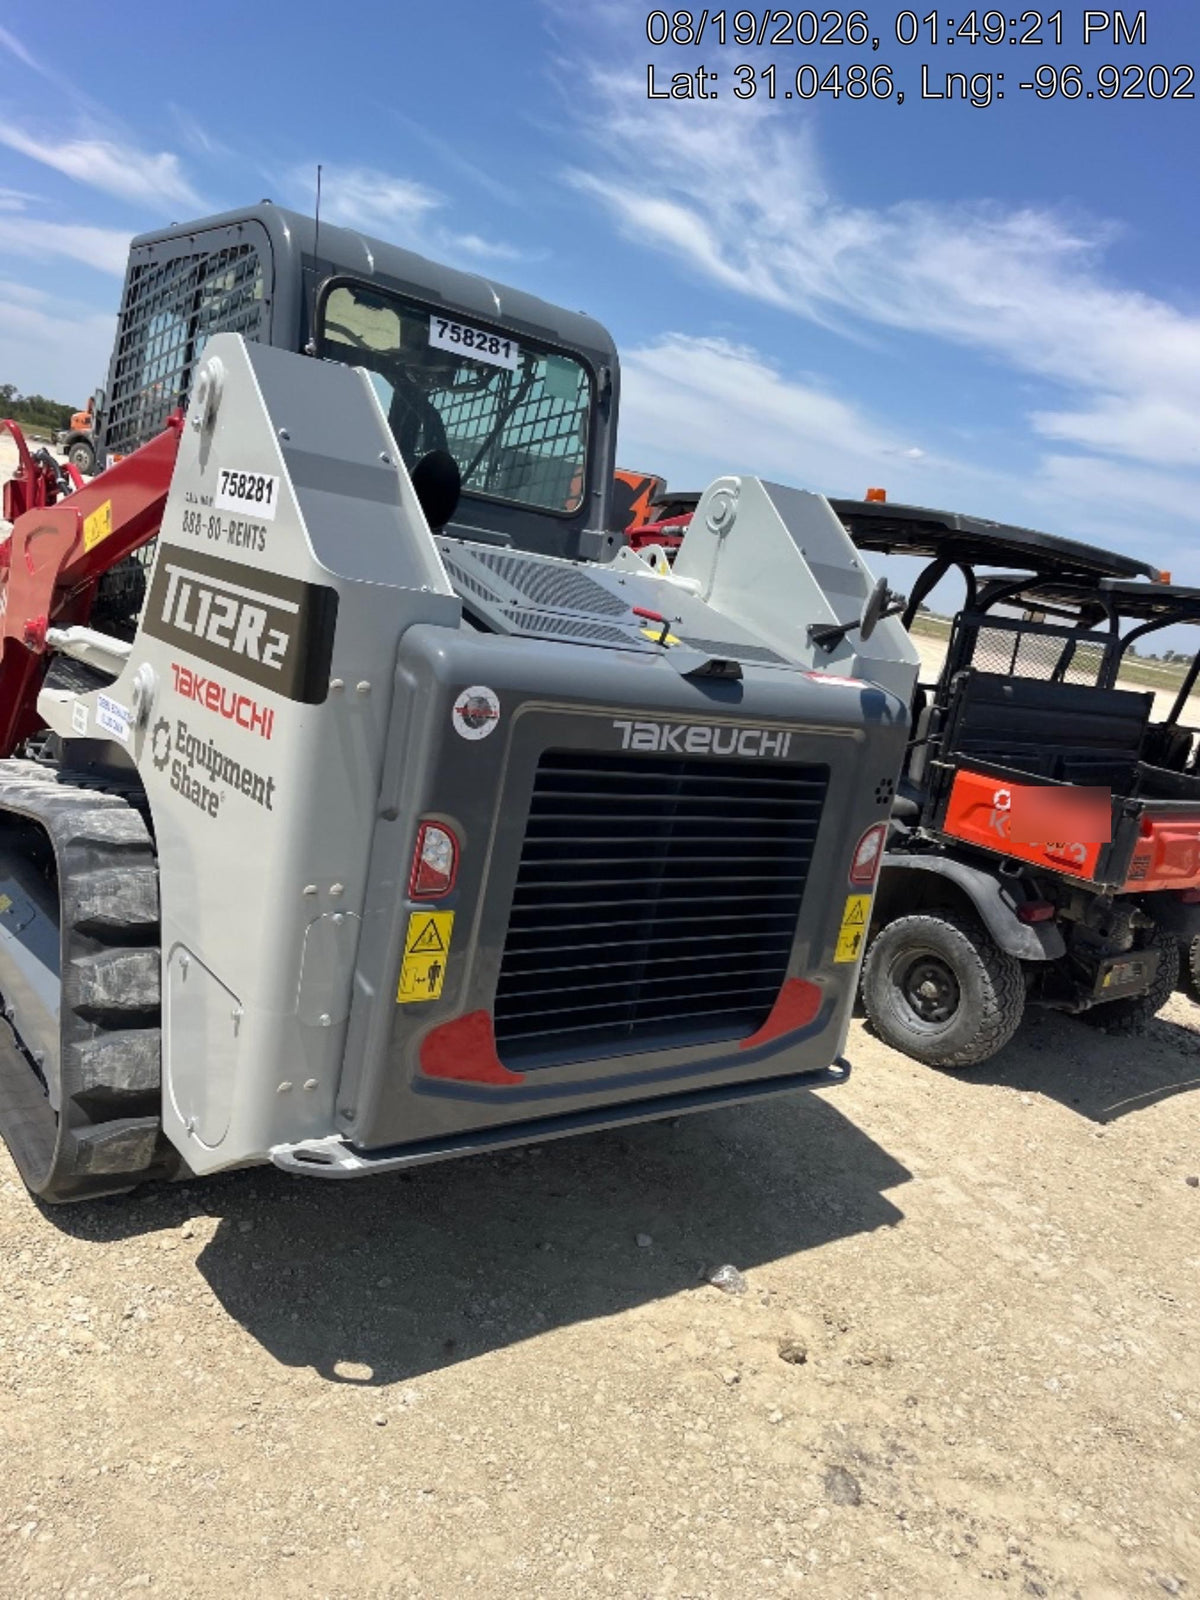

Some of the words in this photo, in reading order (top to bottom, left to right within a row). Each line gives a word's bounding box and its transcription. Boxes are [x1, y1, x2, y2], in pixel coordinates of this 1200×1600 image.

[437, 319, 512, 359] 758281
[221, 471, 275, 504] 758281
[182, 509, 267, 552] 888-80-RENTS
[160, 563, 299, 671] TL12R2
[169, 758, 220, 818] Share
[175, 719, 276, 811] Equipment
